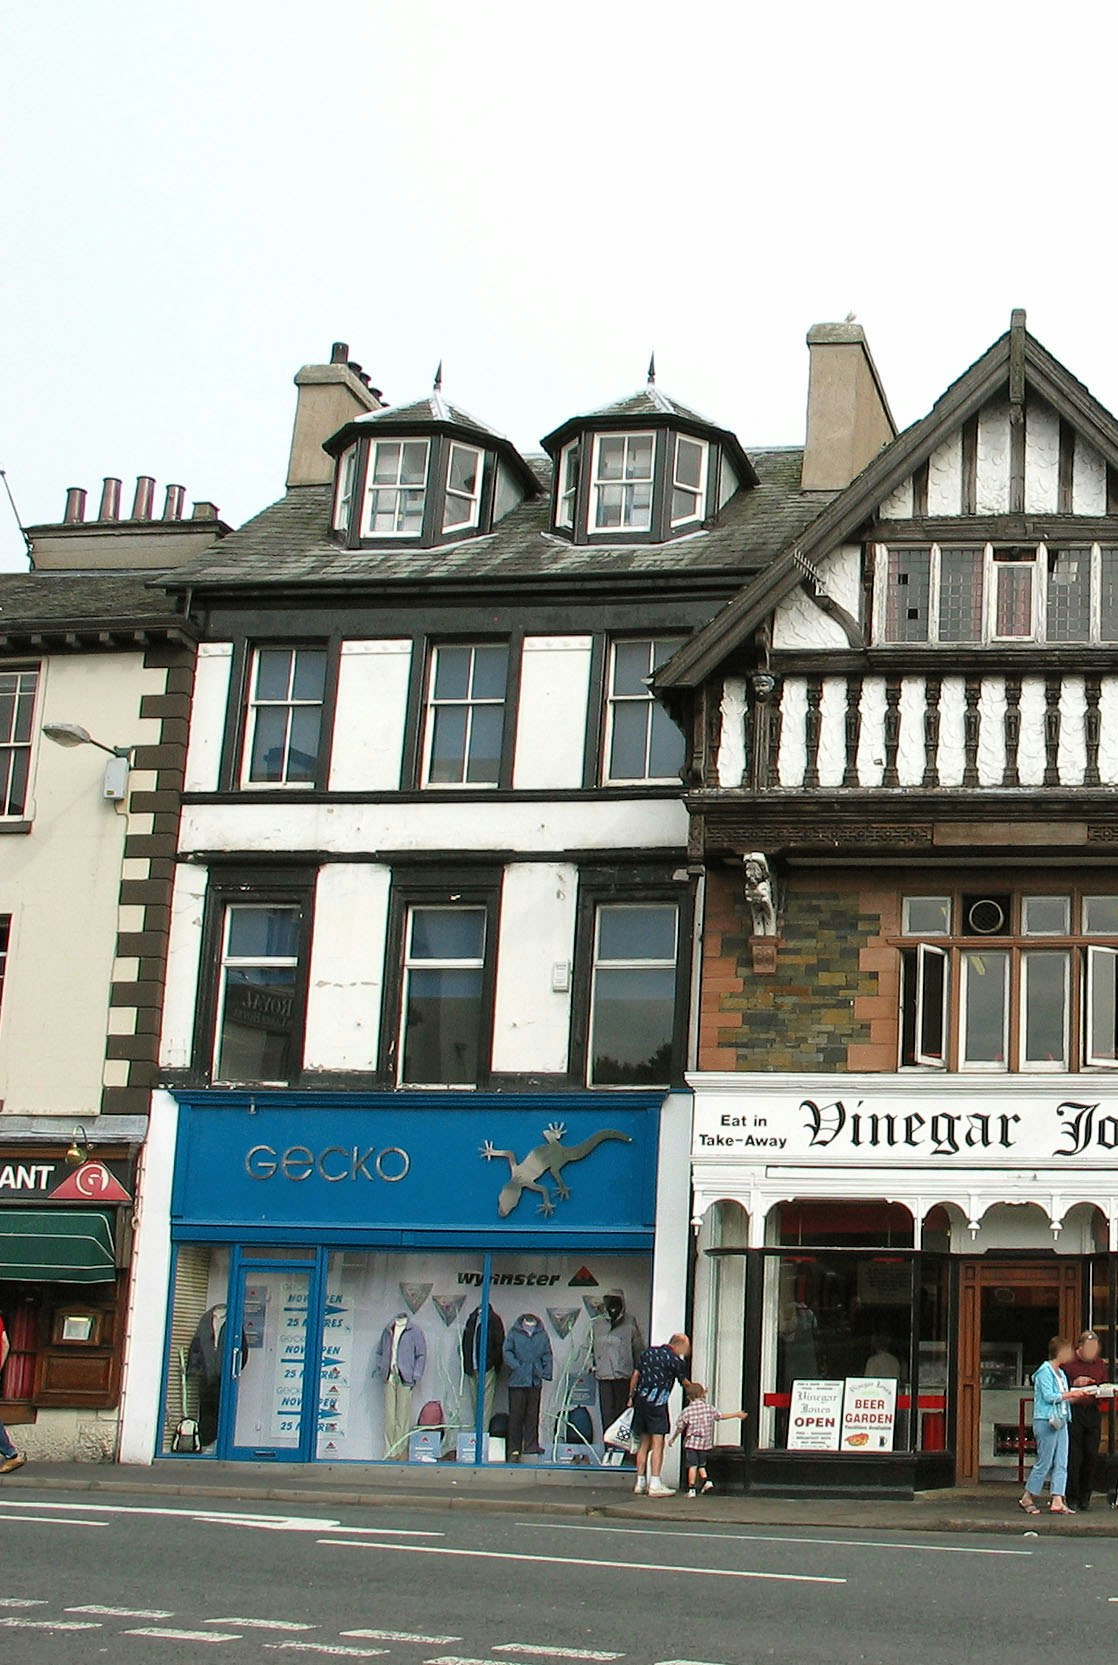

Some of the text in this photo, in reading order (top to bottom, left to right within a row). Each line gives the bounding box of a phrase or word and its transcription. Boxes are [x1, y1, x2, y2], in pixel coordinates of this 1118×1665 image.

[720, 1114, 767, 1127] Eat in
[799, 1100, 1022, 1155] Vinegar
[699, 1134, 787, 1149] Take-Away
[0, 1165, 55, 1190] ANT
[286, 1318, 299, 1328] 25
[321, 1345, 341, 1355] PEN
[284, 1369, 296, 1379] 25
[318, 1397, 338, 1407] PEN
[855, 1399, 885, 1410] BEER
[794, 1417, 835, 1428] OPEN
[845, 1413, 893, 1424] GARDEN
[280, 1421, 293, 1431] 25
